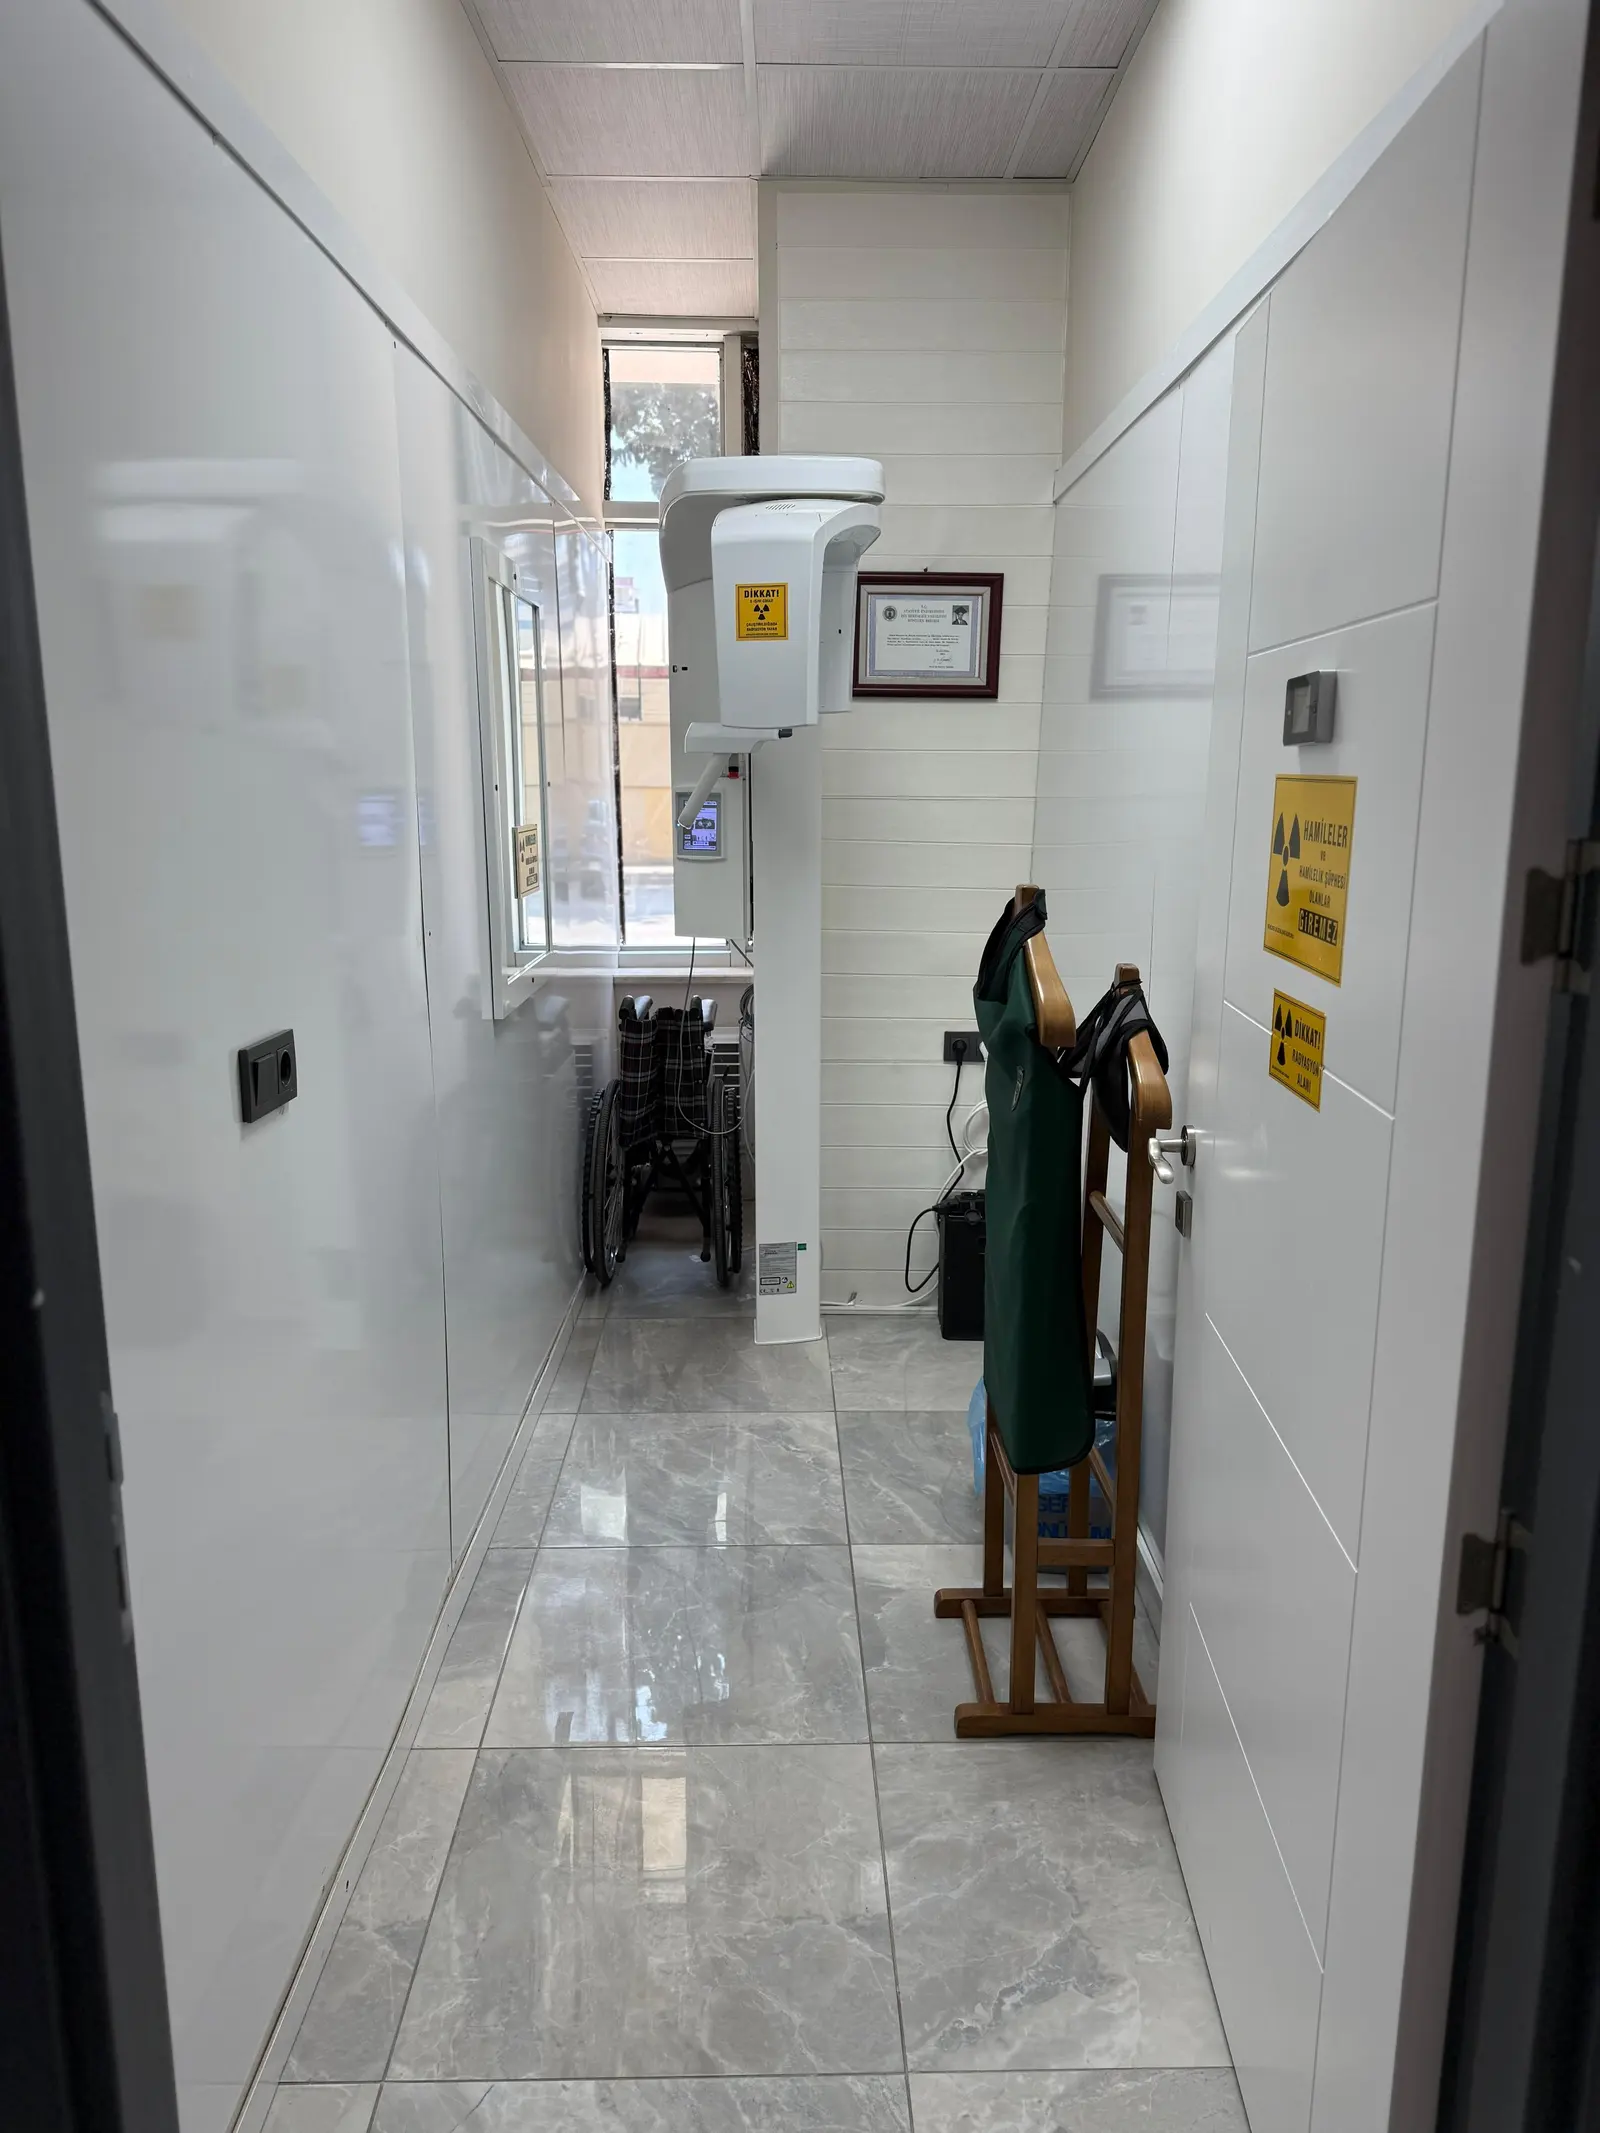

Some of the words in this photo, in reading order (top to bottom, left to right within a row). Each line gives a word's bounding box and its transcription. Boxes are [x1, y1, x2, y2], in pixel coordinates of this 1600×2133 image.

[744, 588, 779, 598] DİKKAT!
[1303, 817, 1348, 849] HAMİLELER
[1299, 864, 1324, 883] HAMİLELİK
[1325, 869, 1346, 890] ŞÜPHESİ
[1309, 889, 1331, 909] OLANLAR
[1299, 909, 1338, 945] GİREMEZ
[1294, 1018, 1321, 1050] DİKKAT!
[1292, 1048, 1319, 1078] RADYASYON
[1296, 1073, 1312, 1094] ALANI
